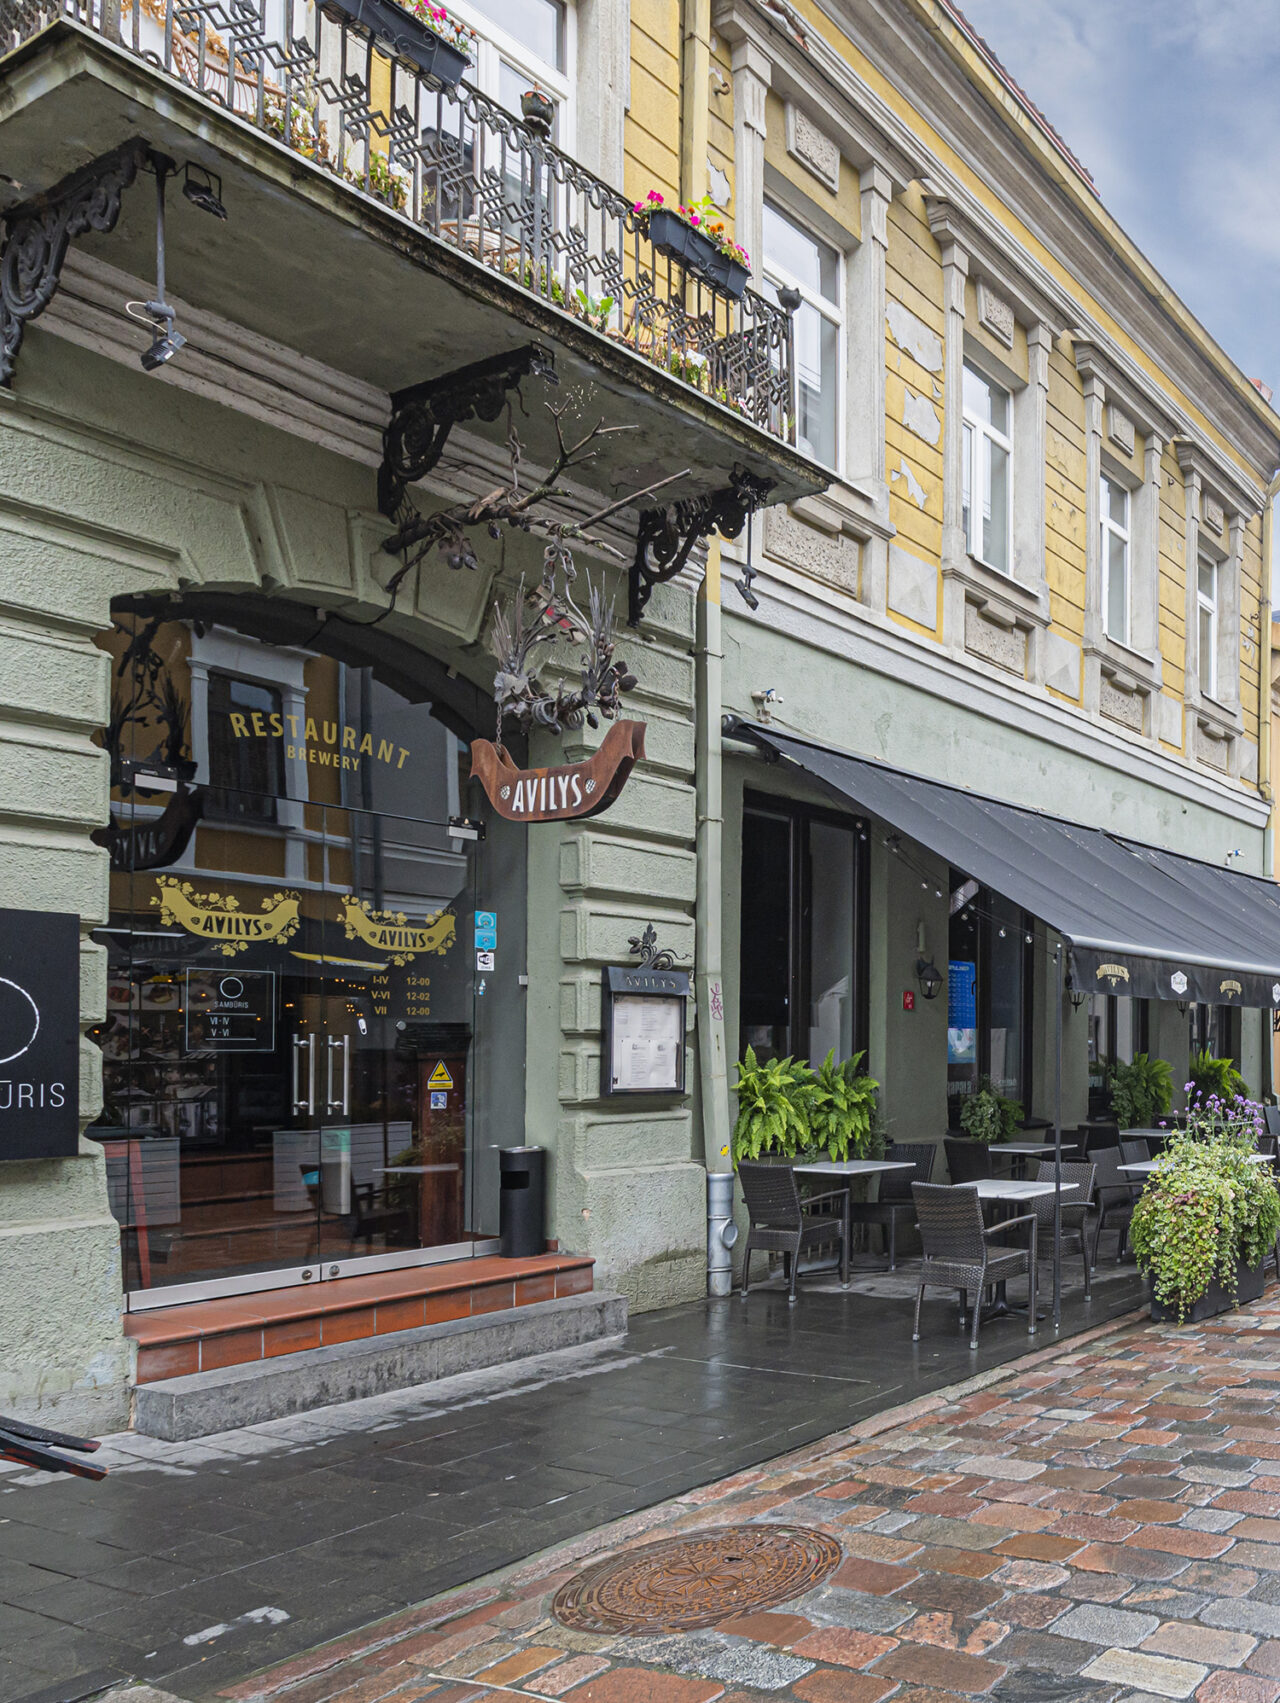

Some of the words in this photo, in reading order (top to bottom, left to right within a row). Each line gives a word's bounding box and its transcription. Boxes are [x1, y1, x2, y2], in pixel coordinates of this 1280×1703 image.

[229, 713, 410, 769] RESTAURANT
[287, 744, 360, 772] BREWERY
[512, 773, 582, 813] AVILYS
[202, 915, 263, 936] AVILYS
[378, 930, 427, 948] AVILYS
[373, 975, 389, 985] I-IV
[407, 977, 430, 986] 12-00
[371, 990, 391, 1000] V-VI
[406, 992, 430, 1001] 12-02
[374, 1006, 387, 1015] VII
[406, 1007, 430, 1016] 12-00
